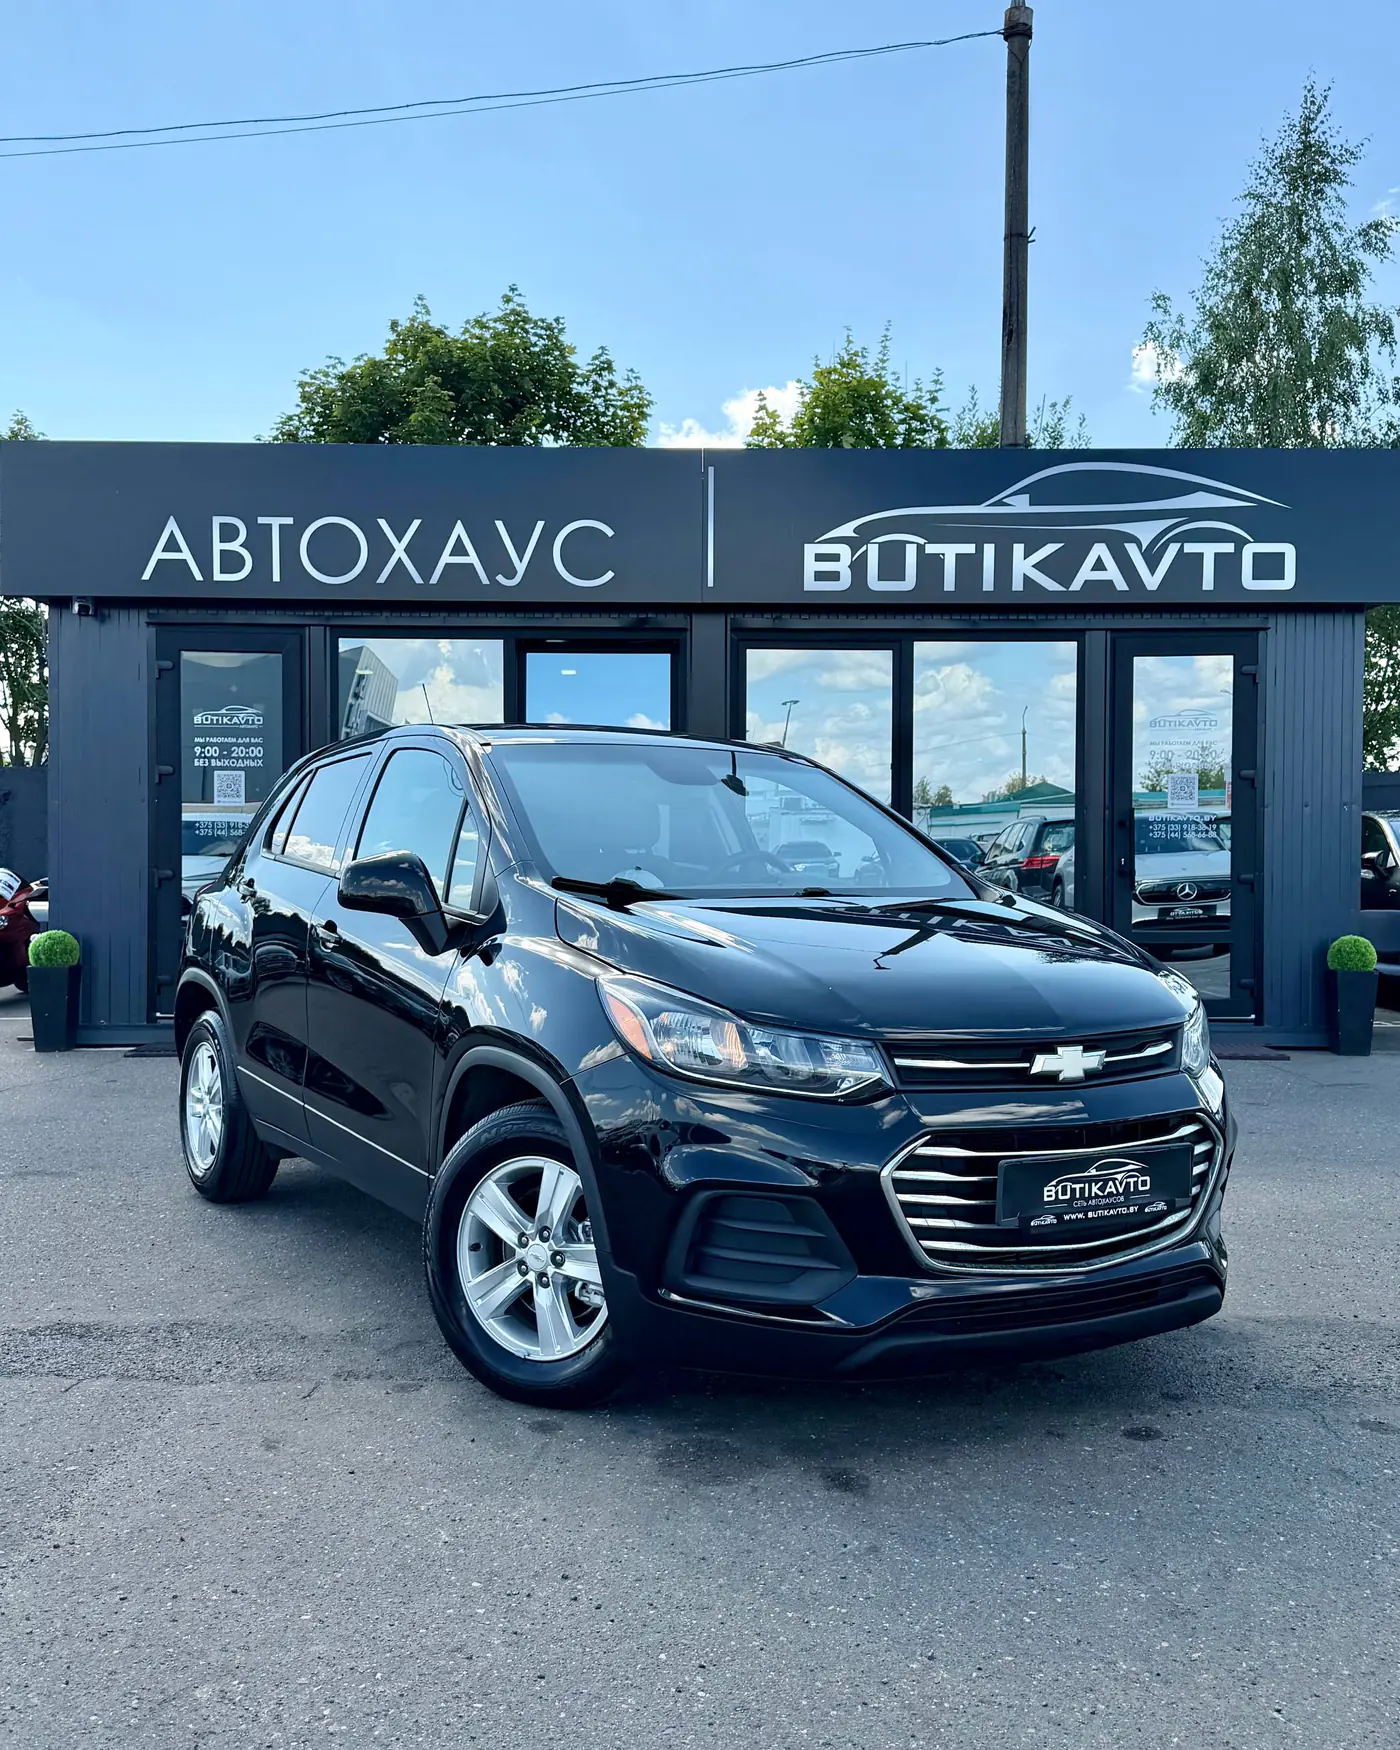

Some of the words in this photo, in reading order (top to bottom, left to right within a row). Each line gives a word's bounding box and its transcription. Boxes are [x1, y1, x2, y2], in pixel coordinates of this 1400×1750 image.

[141, 514, 616, 588] АВТОХАУС
[804, 541, 1296, 592] BUTIKAVTO
[193, 715, 263, 725] BUTIKAVTO
[1149, 719, 1218, 728] BUTIKAVTO
[194, 746, 220, 757] 9:00
[231, 746, 264, 757] 20:00
[1149, 750, 1174, 760] 9:00
[194, 758, 209, 767] БЕЗ
[211, 758, 264, 767] ВЫХОДНЫХ
[214, 821, 228, 829] (33)
[1167, 823, 1181, 832] (33)
[214, 828, 228, 837] (44)
[1167, 831, 1181, 839] (44)
[1043, 1176, 1151, 1202] BUTIKAVTO
[1073, 1200, 1087, 1208] СЕТЬ
[1087, 1196, 1125, 1206] АВТОХАУСОВ
[1063, 1212, 1086, 1221] WWW.
[1088, 1206, 1139, 1218] BUTIKAVTO.BY
